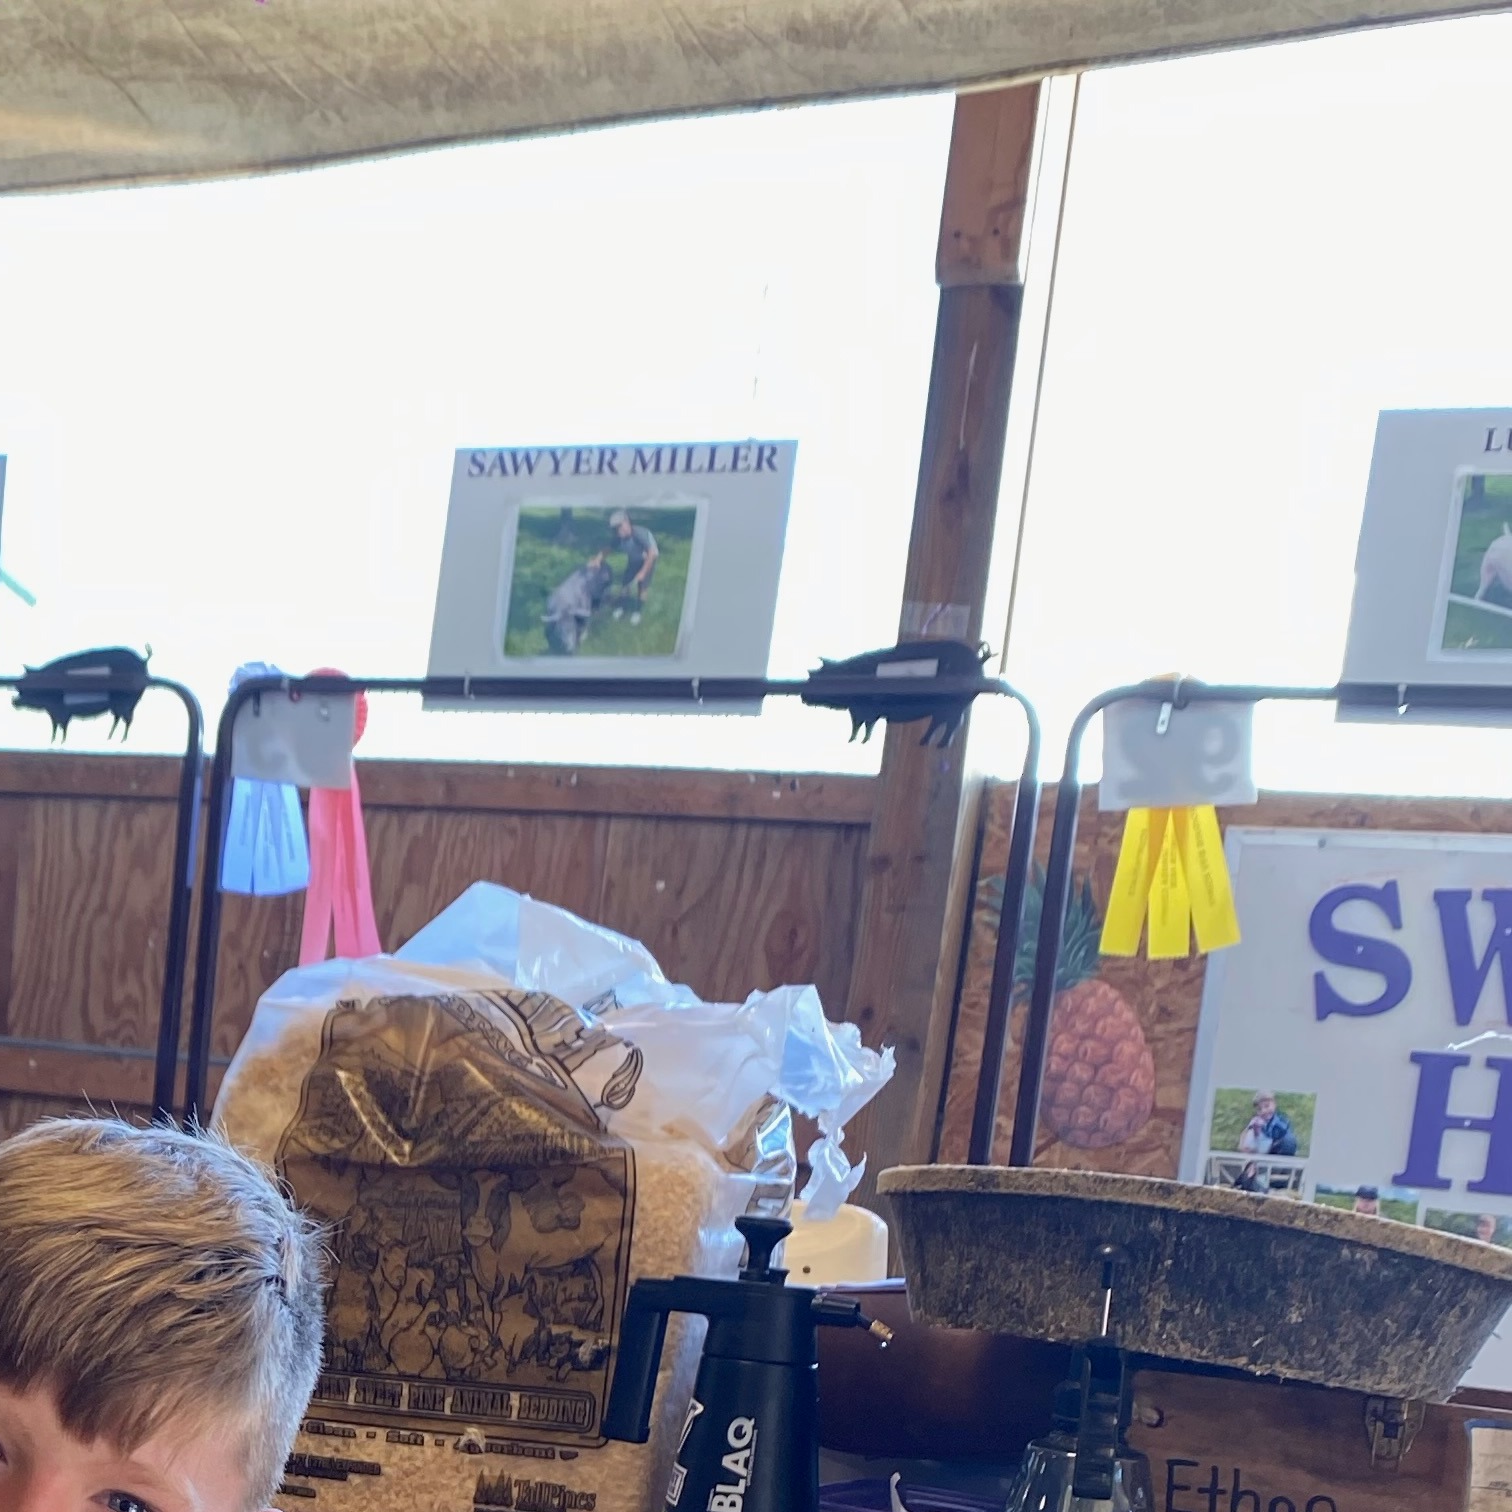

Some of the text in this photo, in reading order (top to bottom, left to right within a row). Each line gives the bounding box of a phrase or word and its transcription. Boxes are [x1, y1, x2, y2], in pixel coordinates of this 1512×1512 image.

[467, 443, 778, 478] SAWYER MILLER
[408, 1383, 446, 1413] PINE
[450, 1388, 512, 1418] ANIMAL
[517, 1394, 587, 1425] BEDDING
